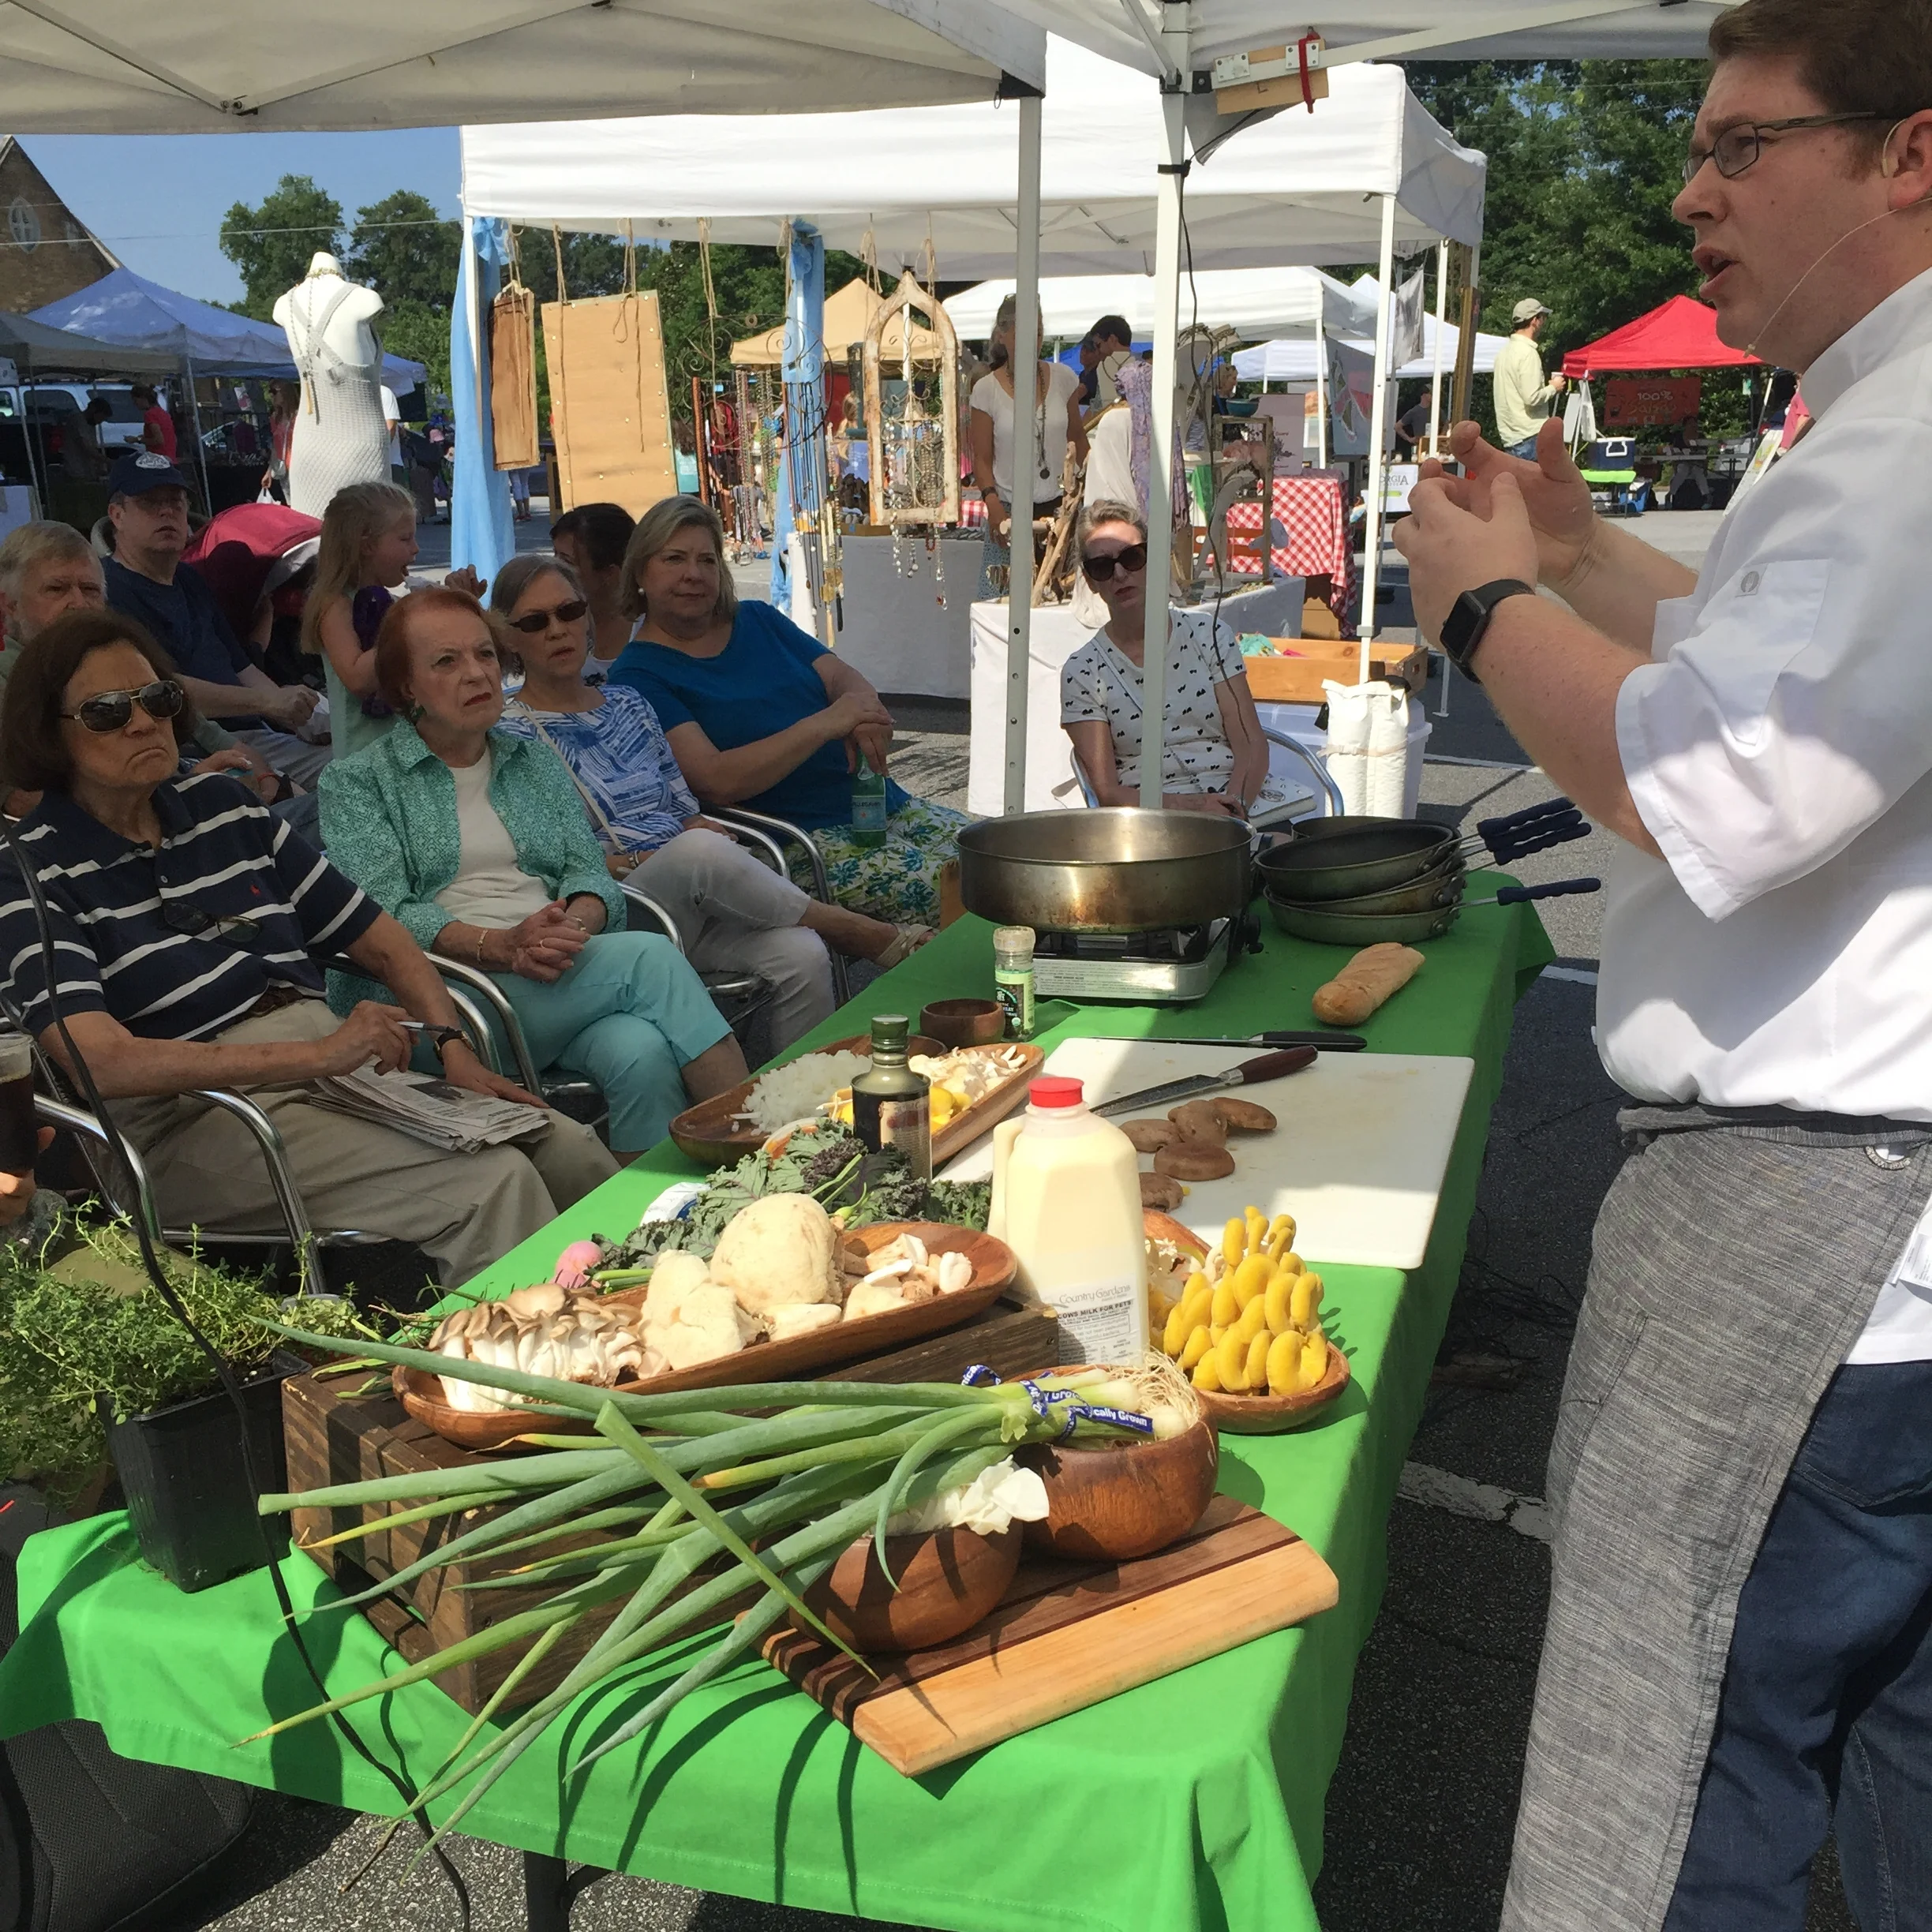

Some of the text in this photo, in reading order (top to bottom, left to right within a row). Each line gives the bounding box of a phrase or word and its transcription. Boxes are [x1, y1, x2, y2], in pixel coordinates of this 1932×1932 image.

[1637, 390, 1673, 401] 100%
[1059, 1292, 1095, 1305] Country
[1095, 1285, 1130, 1297] Gardens
[1080, 1307, 1099, 1316] MILK
[1114, 1300, 1132, 1309] PETS
[1118, 1410, 1148, 1427] Grown
